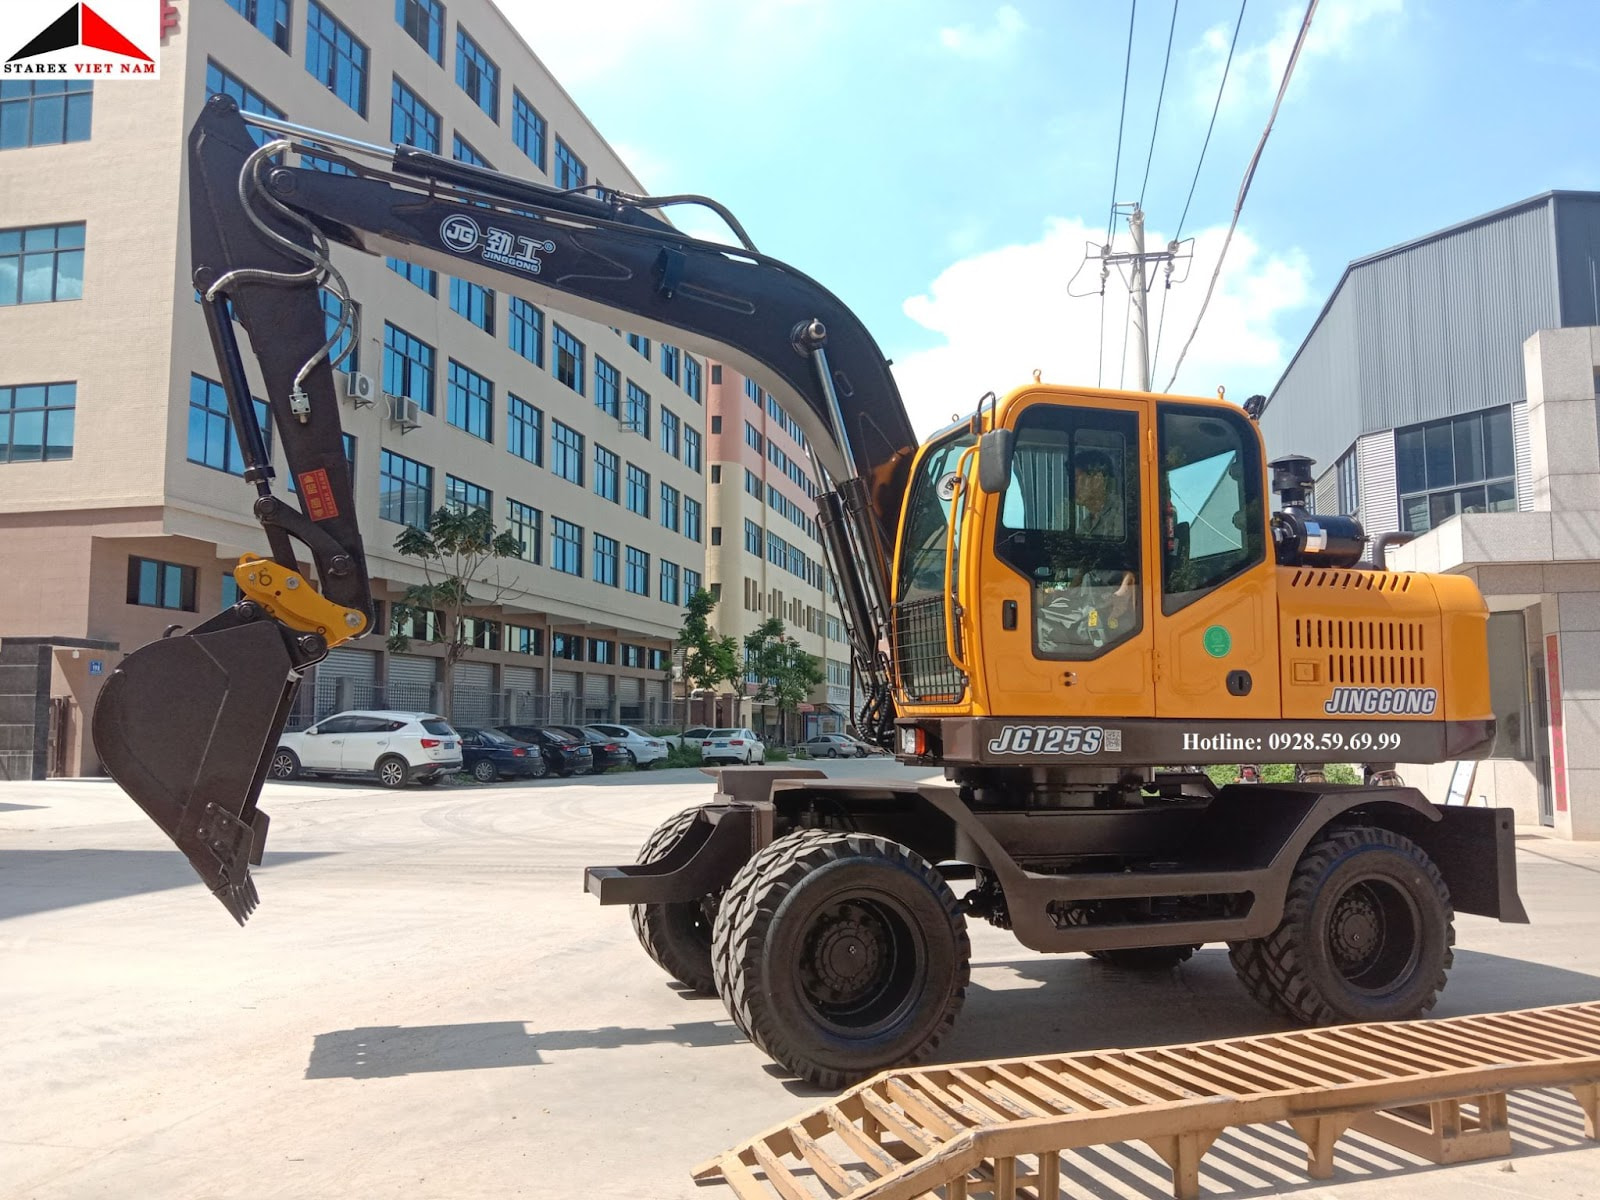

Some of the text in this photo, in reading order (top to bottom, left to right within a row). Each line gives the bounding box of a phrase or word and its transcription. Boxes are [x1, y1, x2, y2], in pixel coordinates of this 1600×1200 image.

[446, 222, 475, 243] JG
[484, 251, 539, 272] JINGGONG
[1324, 688, 1437, 714] JINGGONG
[989, 727, 1102, 753] JG125S
